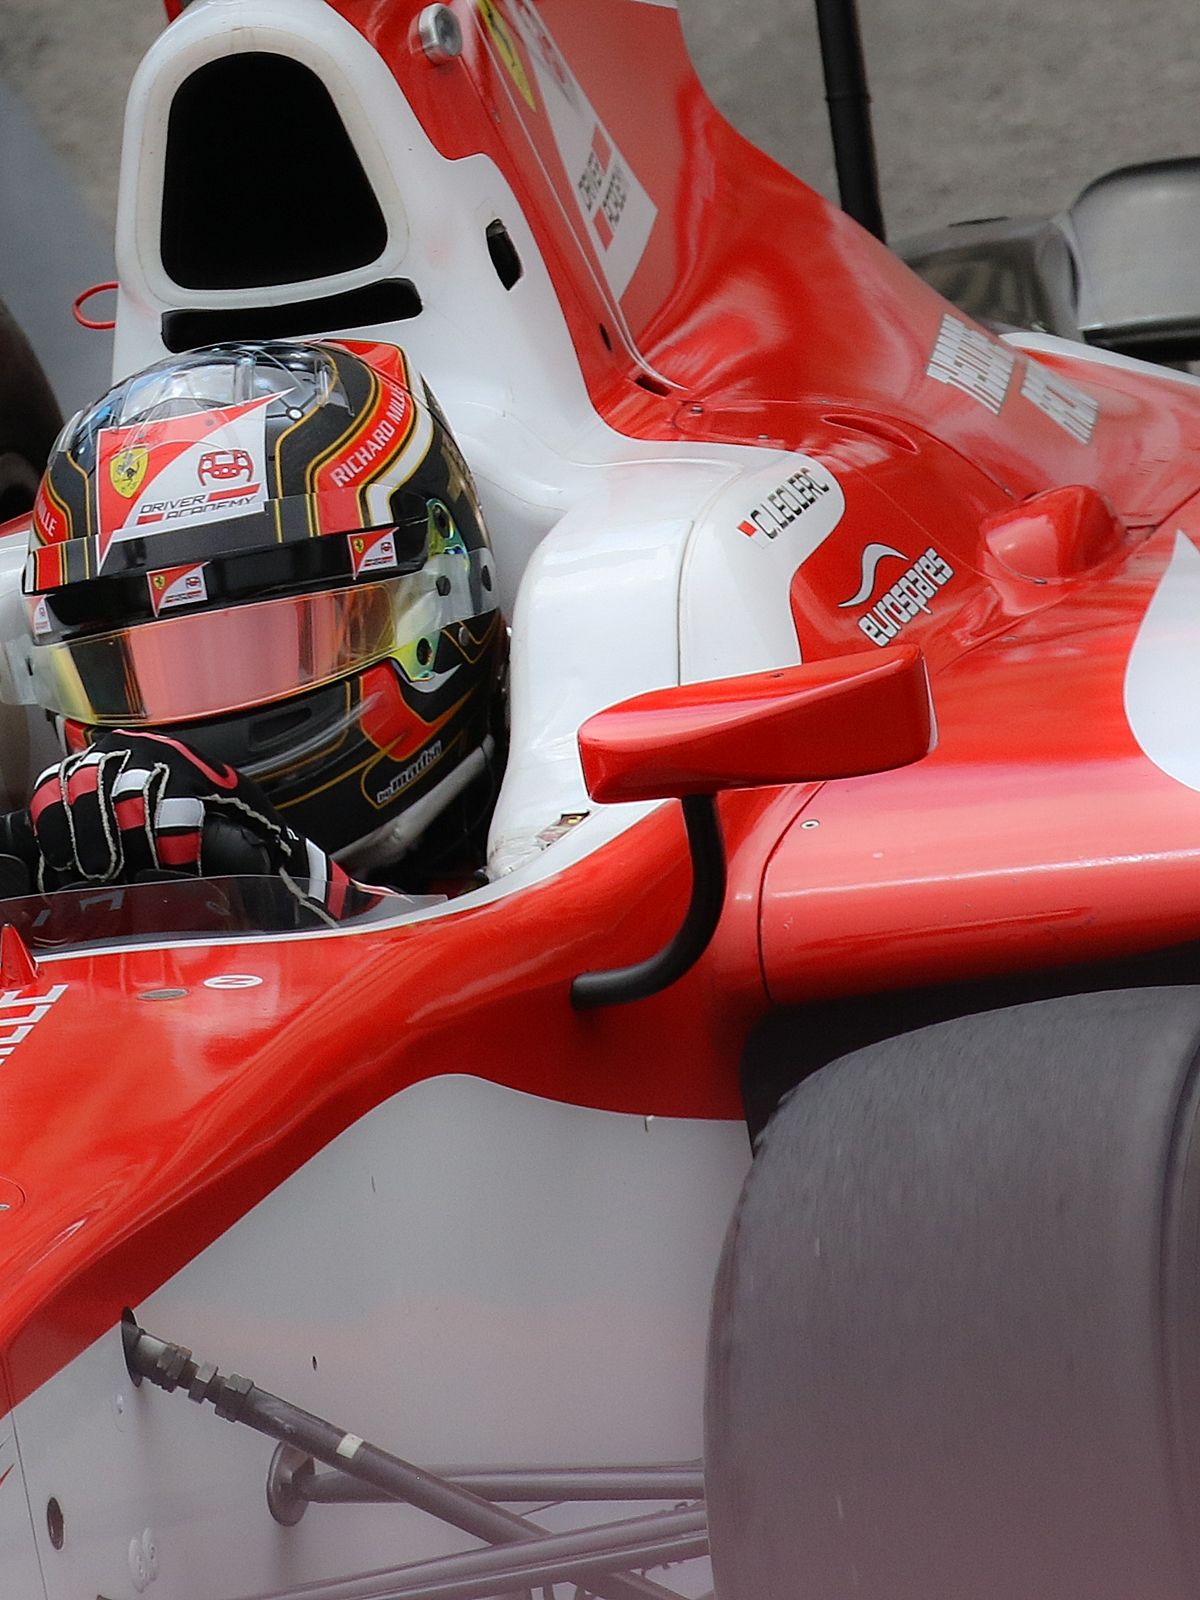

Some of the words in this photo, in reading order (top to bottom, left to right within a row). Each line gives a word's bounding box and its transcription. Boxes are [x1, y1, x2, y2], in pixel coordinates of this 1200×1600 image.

[329, 419, 396, 488] RICHARD
[140, 494, 206, 514] DRIVER
[751, 468, 830, 540] C.LECLERC
[856, 546, 956, 648] eurospares
